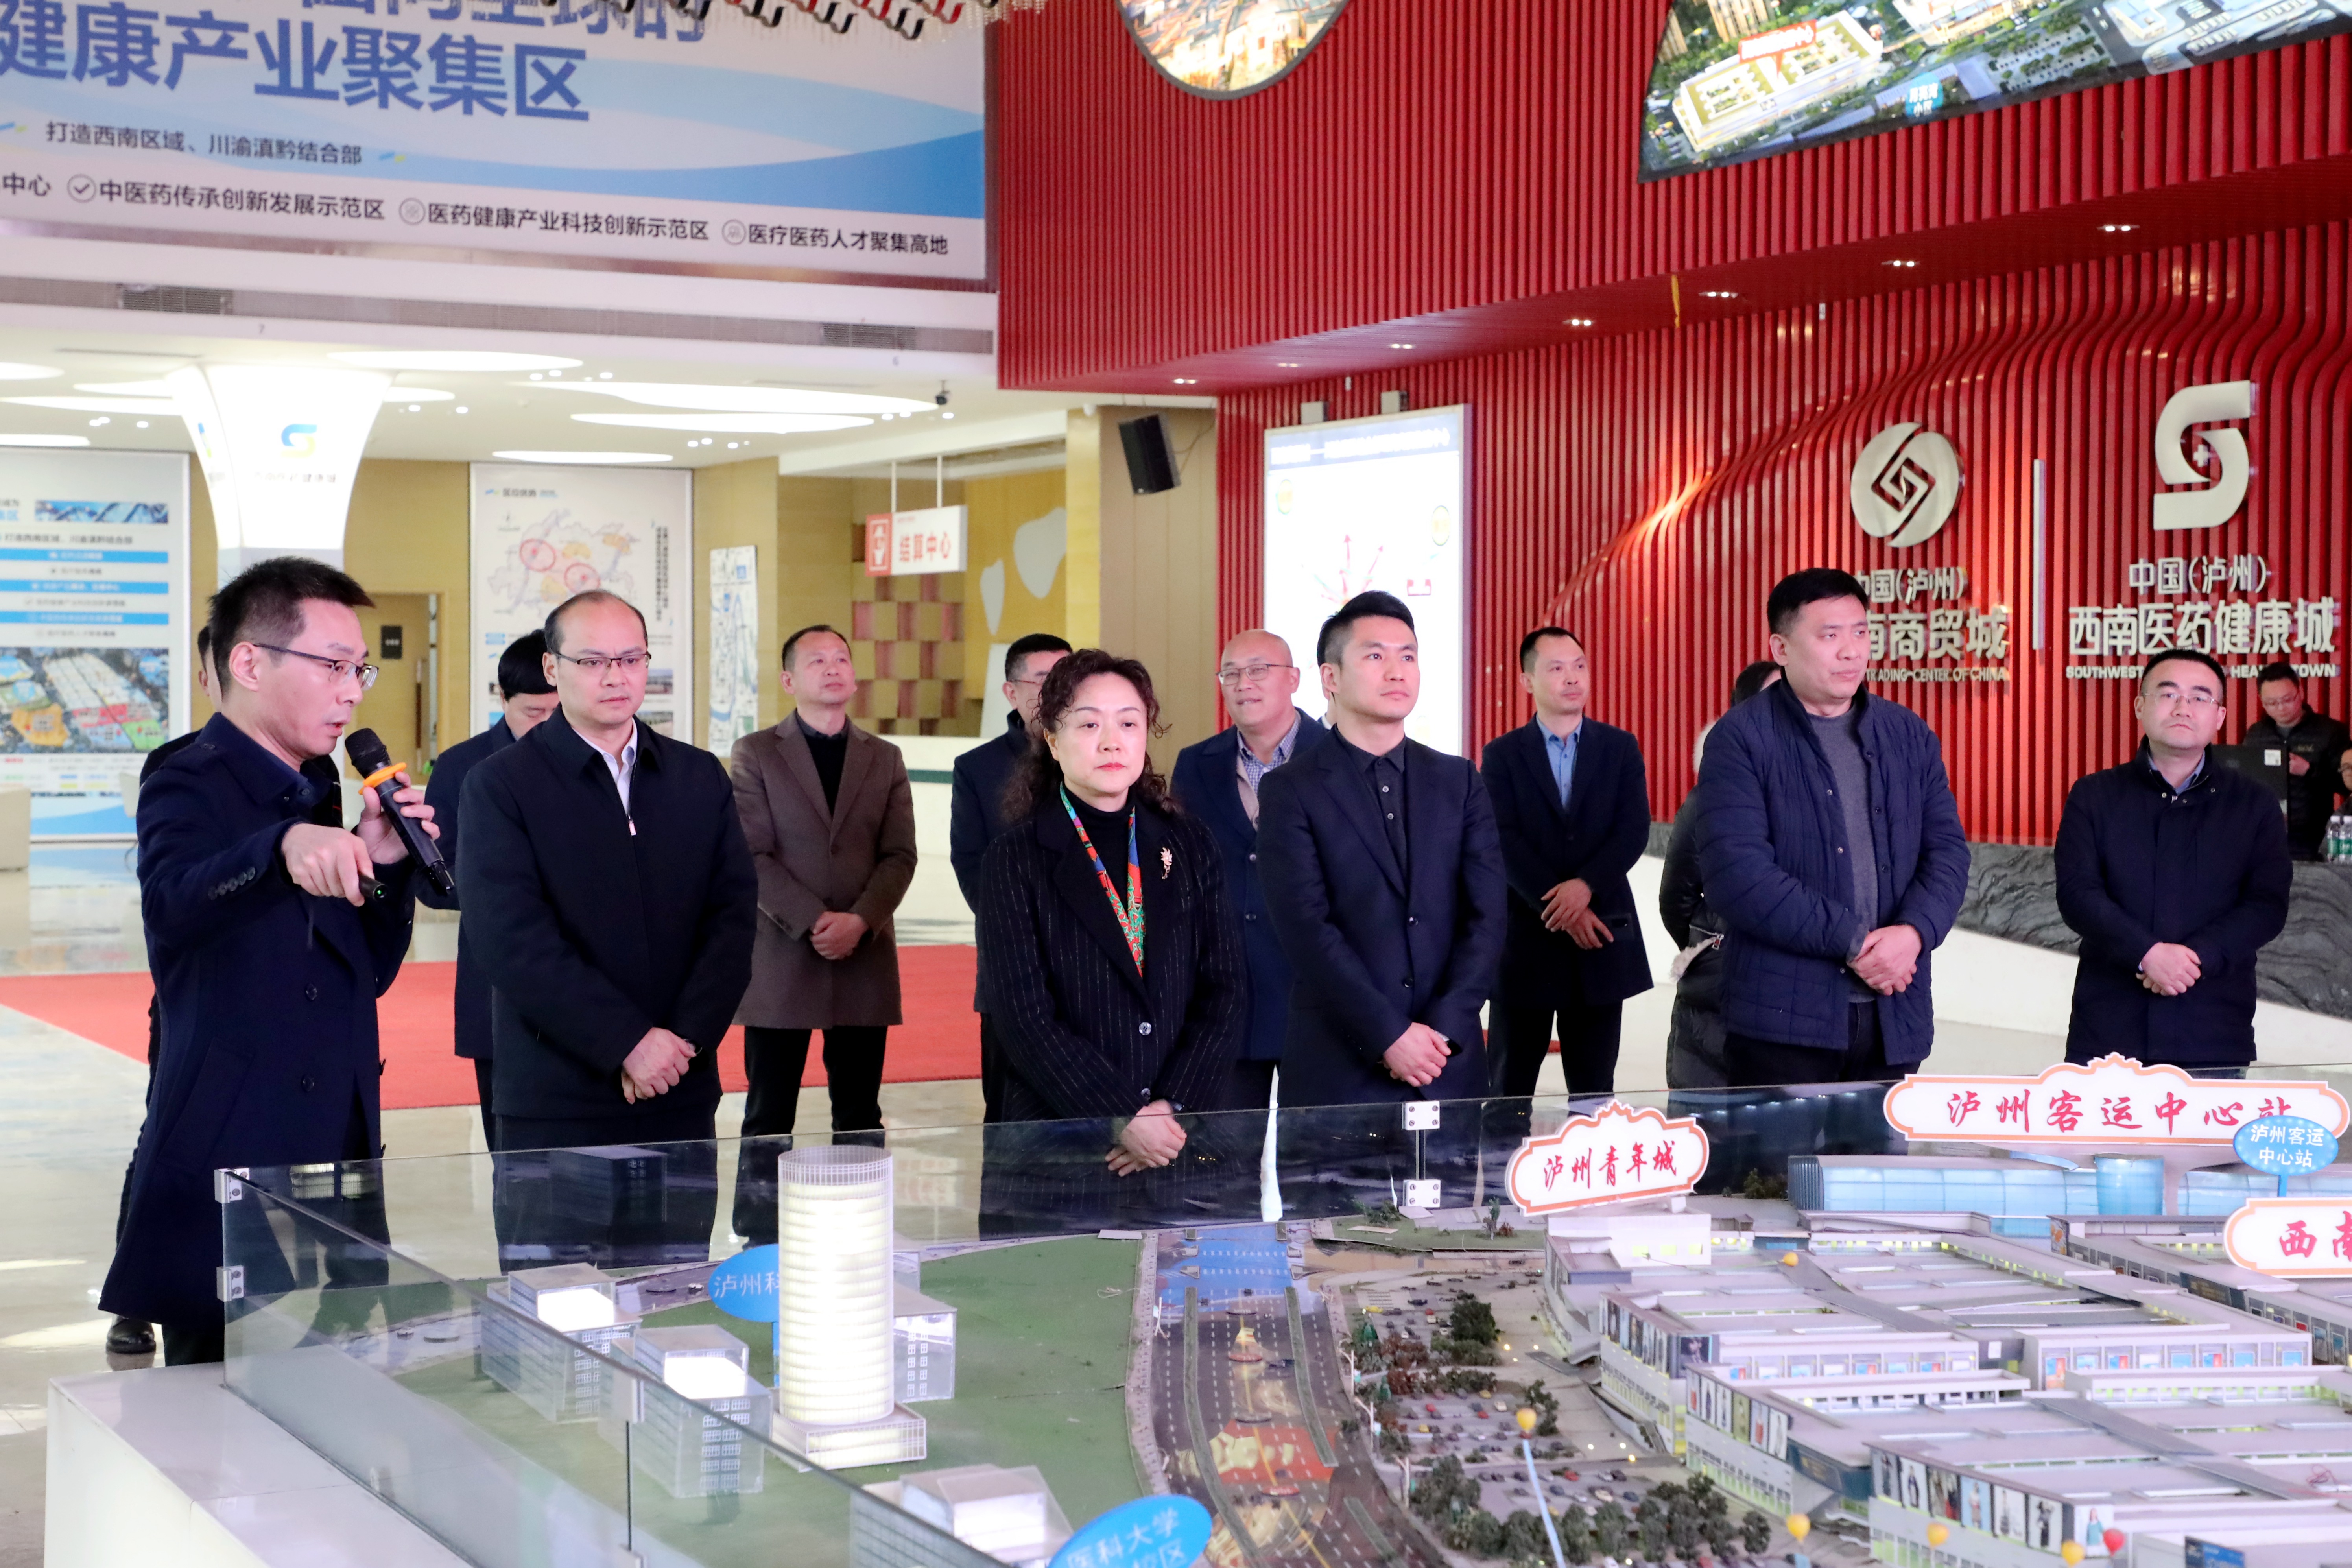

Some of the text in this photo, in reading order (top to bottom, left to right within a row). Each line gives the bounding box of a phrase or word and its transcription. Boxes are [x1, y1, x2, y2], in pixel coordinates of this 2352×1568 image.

[0, 0, 589, 121] 健康产业聚集区
[2, 172, 948, 255] 中心 中医药传承创新发展示范区 医药健康产业科技创新示范区 医疗医药人才聚集高地
[2068, 596, 2335, 656] 西南医药健康城
[2066, 665, 2144, 679] SOUTHWEST
[2250, 1124, 2324, 1147] 泸州客运
[2259, 1146, 2313, 1168] 中心站
[1544, 1139, 1677, 1192] 泸州青年城
